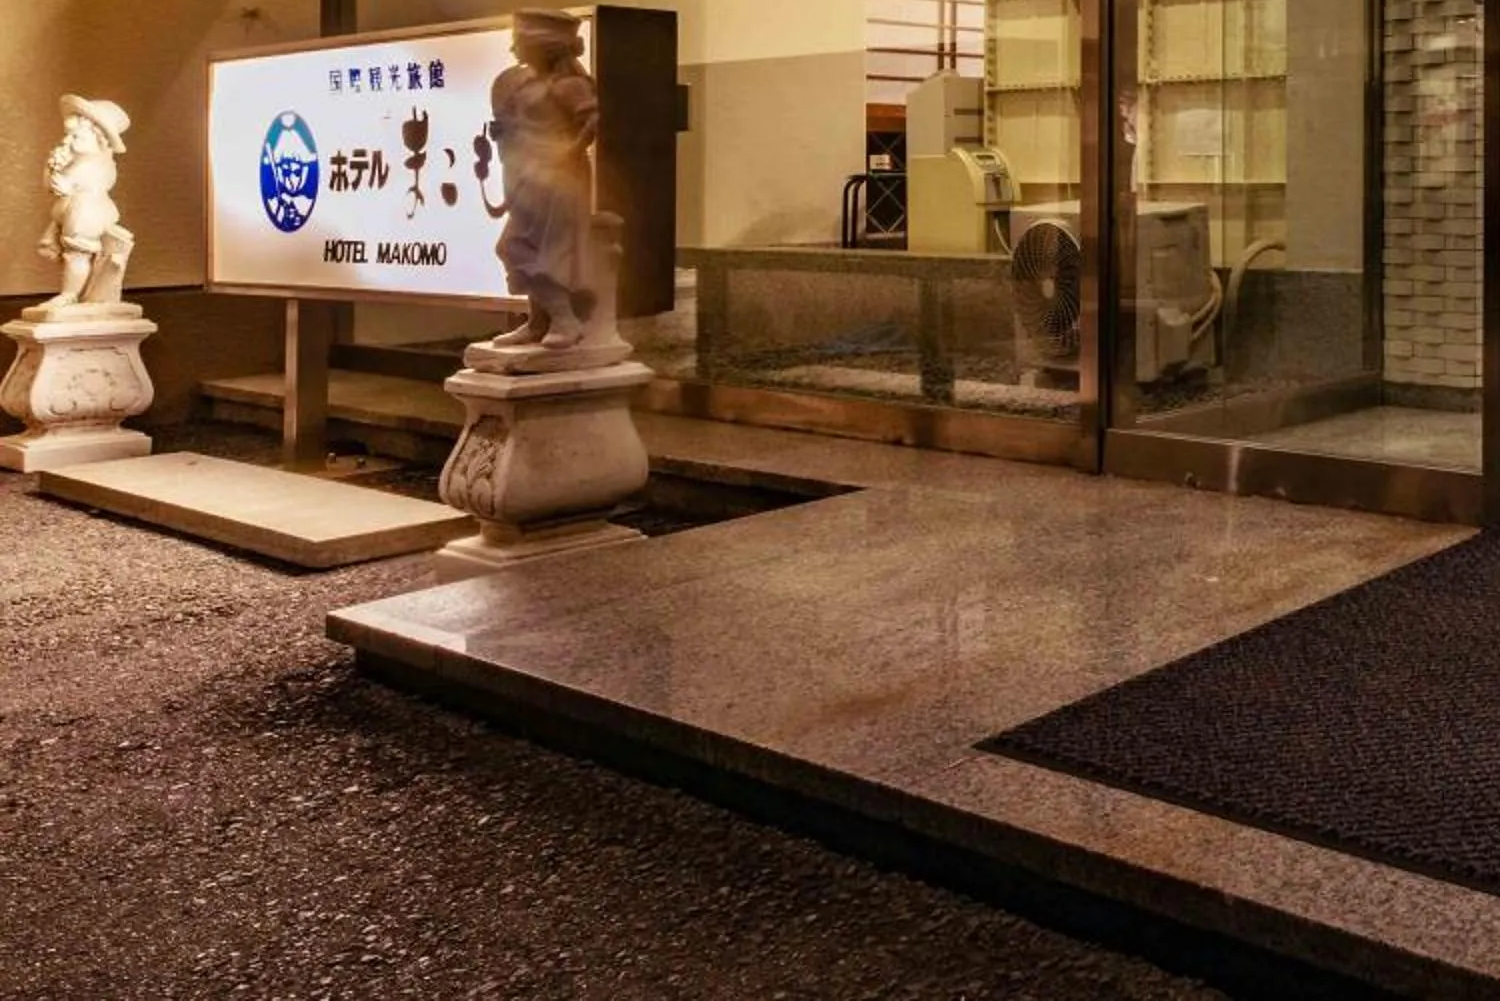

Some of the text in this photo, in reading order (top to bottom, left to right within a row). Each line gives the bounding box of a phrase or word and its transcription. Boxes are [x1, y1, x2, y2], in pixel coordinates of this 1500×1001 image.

[328, 149, 390, 192] ホテル
[323, 239, 448, 266] HOTEL MAKOMO
